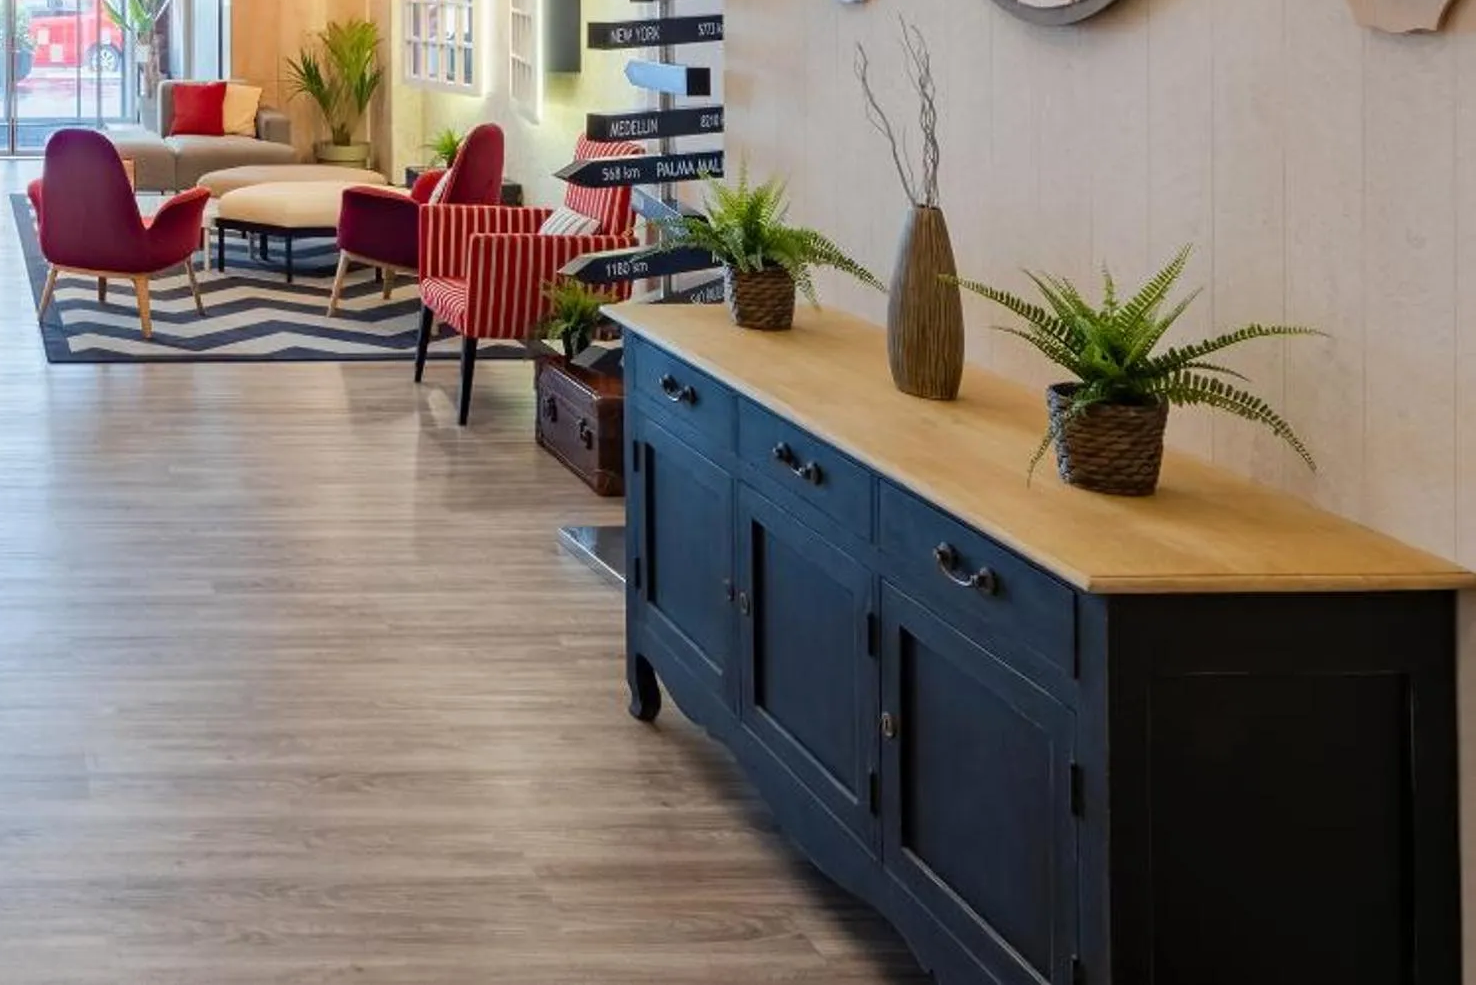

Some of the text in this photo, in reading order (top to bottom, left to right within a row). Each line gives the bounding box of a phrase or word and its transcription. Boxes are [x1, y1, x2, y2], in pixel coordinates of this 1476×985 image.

[635, 24, 661, 42] YORK
[602, 167, 622, 181] 568
[624, 166, 641, 179] km
[656, 160, 696, 178] PALMA
